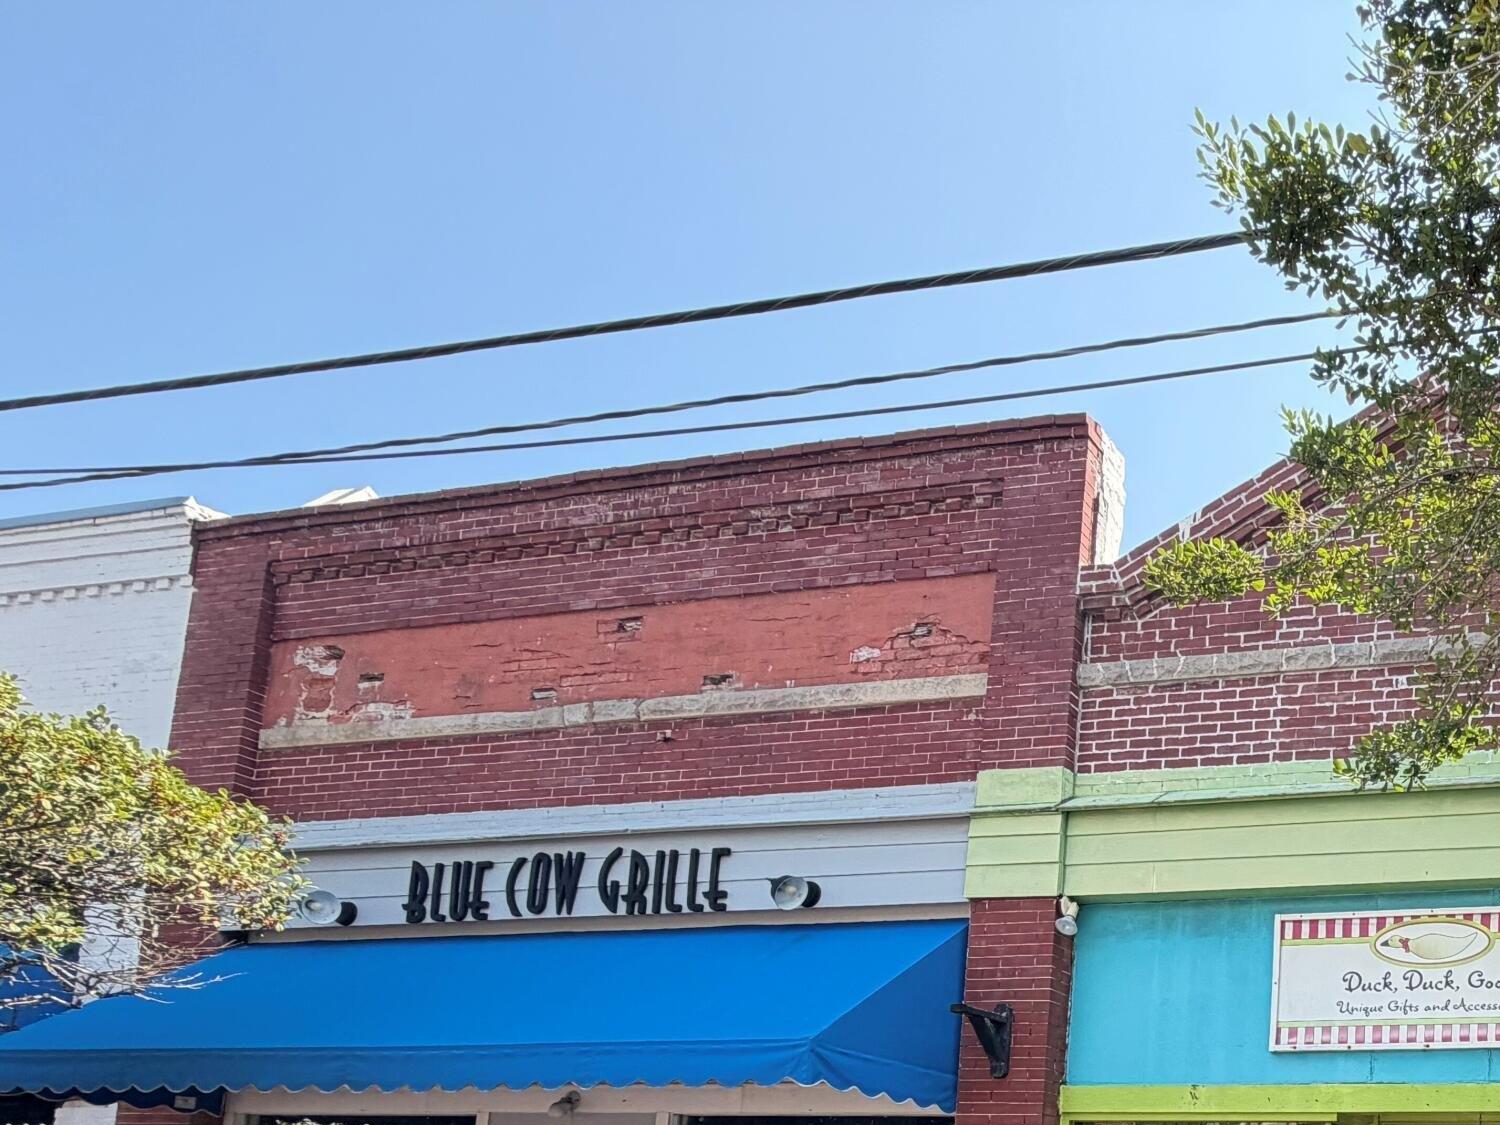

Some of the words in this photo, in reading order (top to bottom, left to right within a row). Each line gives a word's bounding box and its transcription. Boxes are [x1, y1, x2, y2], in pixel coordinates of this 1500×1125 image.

[401, 860, 494, 924] BLUE
[505, 851, 586, 917] COW
[597, 847, 731, 915] GRILLE
[1342, 971, 1398, 994] Duck,
[1402, 969, 1460, 992] Duck,
[1336, 1000, 1384, 1017] Unique
[1387, 1000, 1419, 1015] Gifts
[1424, 1000, 1450, 1012] and
